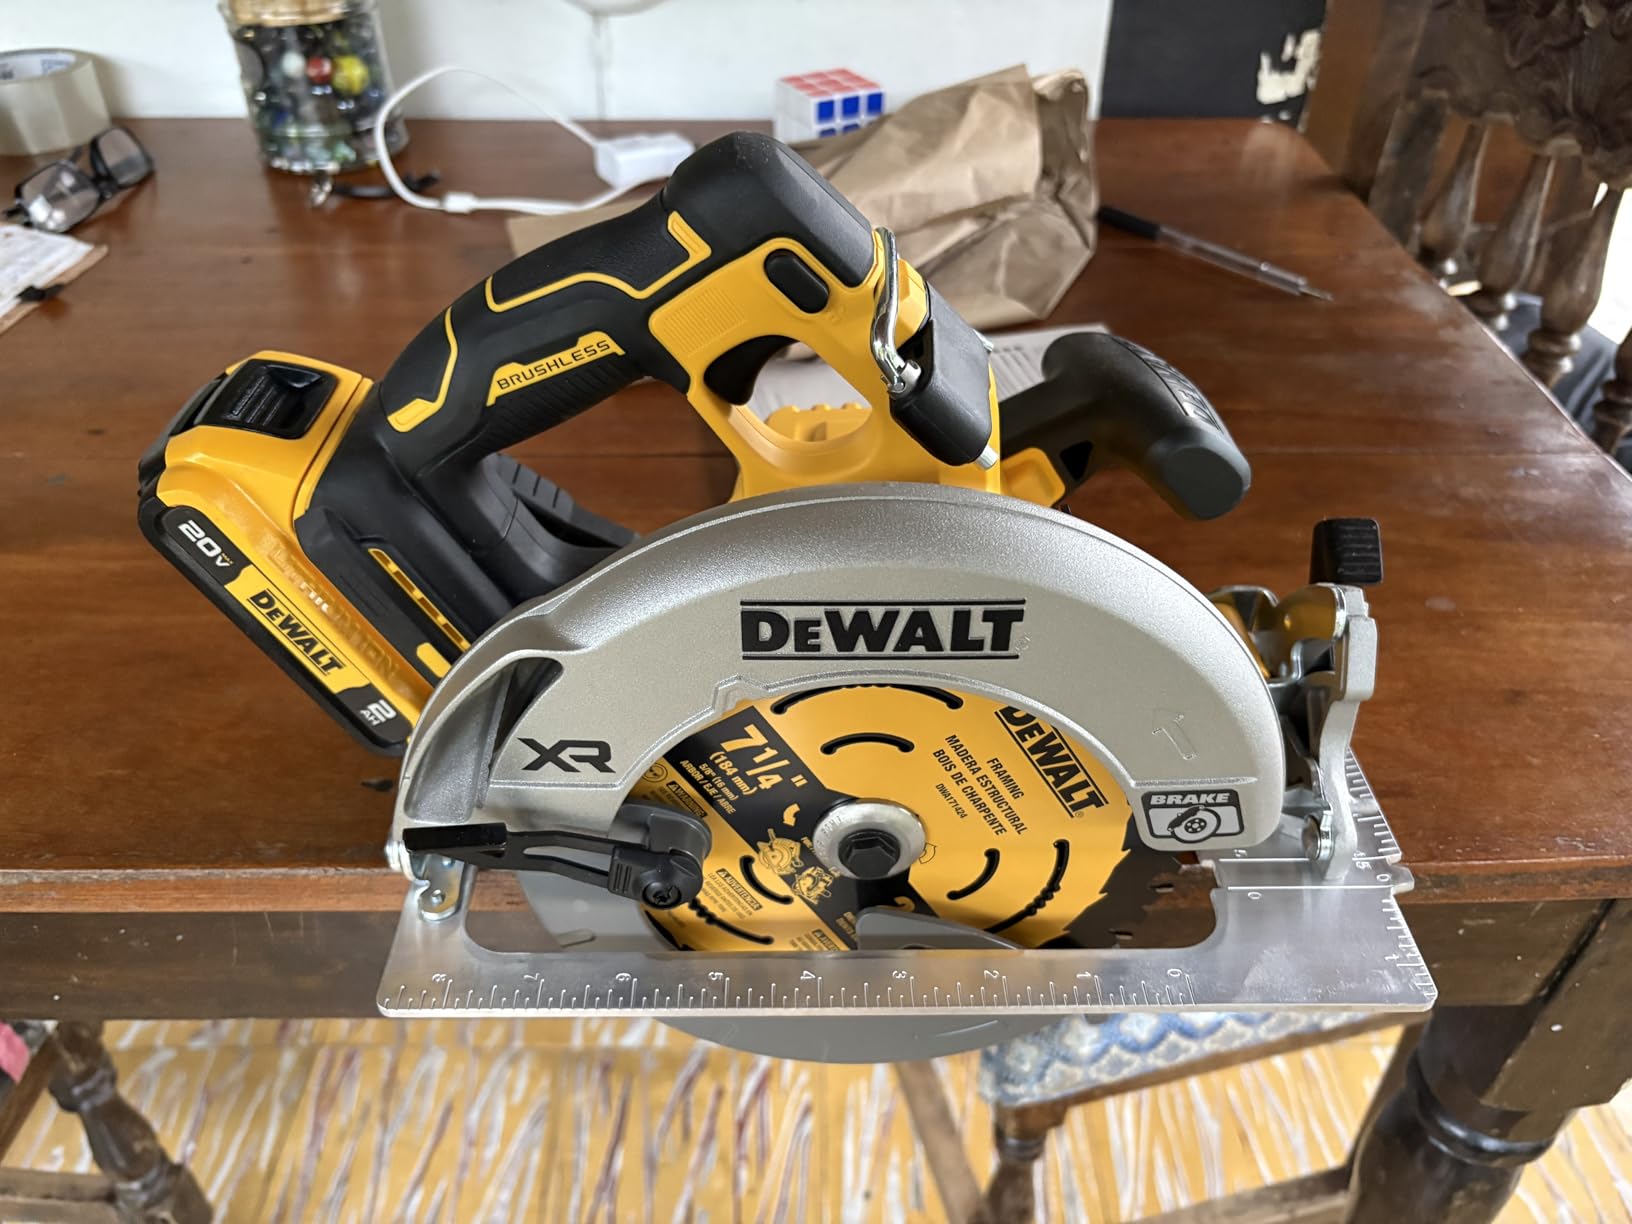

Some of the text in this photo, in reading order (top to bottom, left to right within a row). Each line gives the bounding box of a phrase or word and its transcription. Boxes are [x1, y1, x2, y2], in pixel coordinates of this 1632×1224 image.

[497, 340, 611, 390] BRUSHLESS
[249, 590, 343, 672] DEWALT
[740, 606, 1025, 654] DEWALT
[367, 699, 397, 723] 2
[517, 737, 616, 773] XR
[709, 751, 758, 795] (184 mm)
[998, 705, 1105, 813] DEWALT
[680, 759, 705, 781] ARBOR
[703, 782, 719, 796] EJE
[933, 748, 1007, 836] BOIS DE CHARPENTE
[945, 734, 1028, 835] MADERA ESTRUCTURAL
[986, 757, 1024, 800] FRAMING
[1150, 792, 1231, 805] BRAKE
[935, 783, 968, 819] DWA171424
[432, 973, 447, 982] 8
[523, 972, 541, 981] 7
[616, 973, 632, 981] 6
[708, 971, 724, 980] 5
[800, 970, 816, 980] 4
[892, 970, 908, 979] 3
[984, 969, 1000, 979] 2
[1167, 967, 1183, 977] 0
